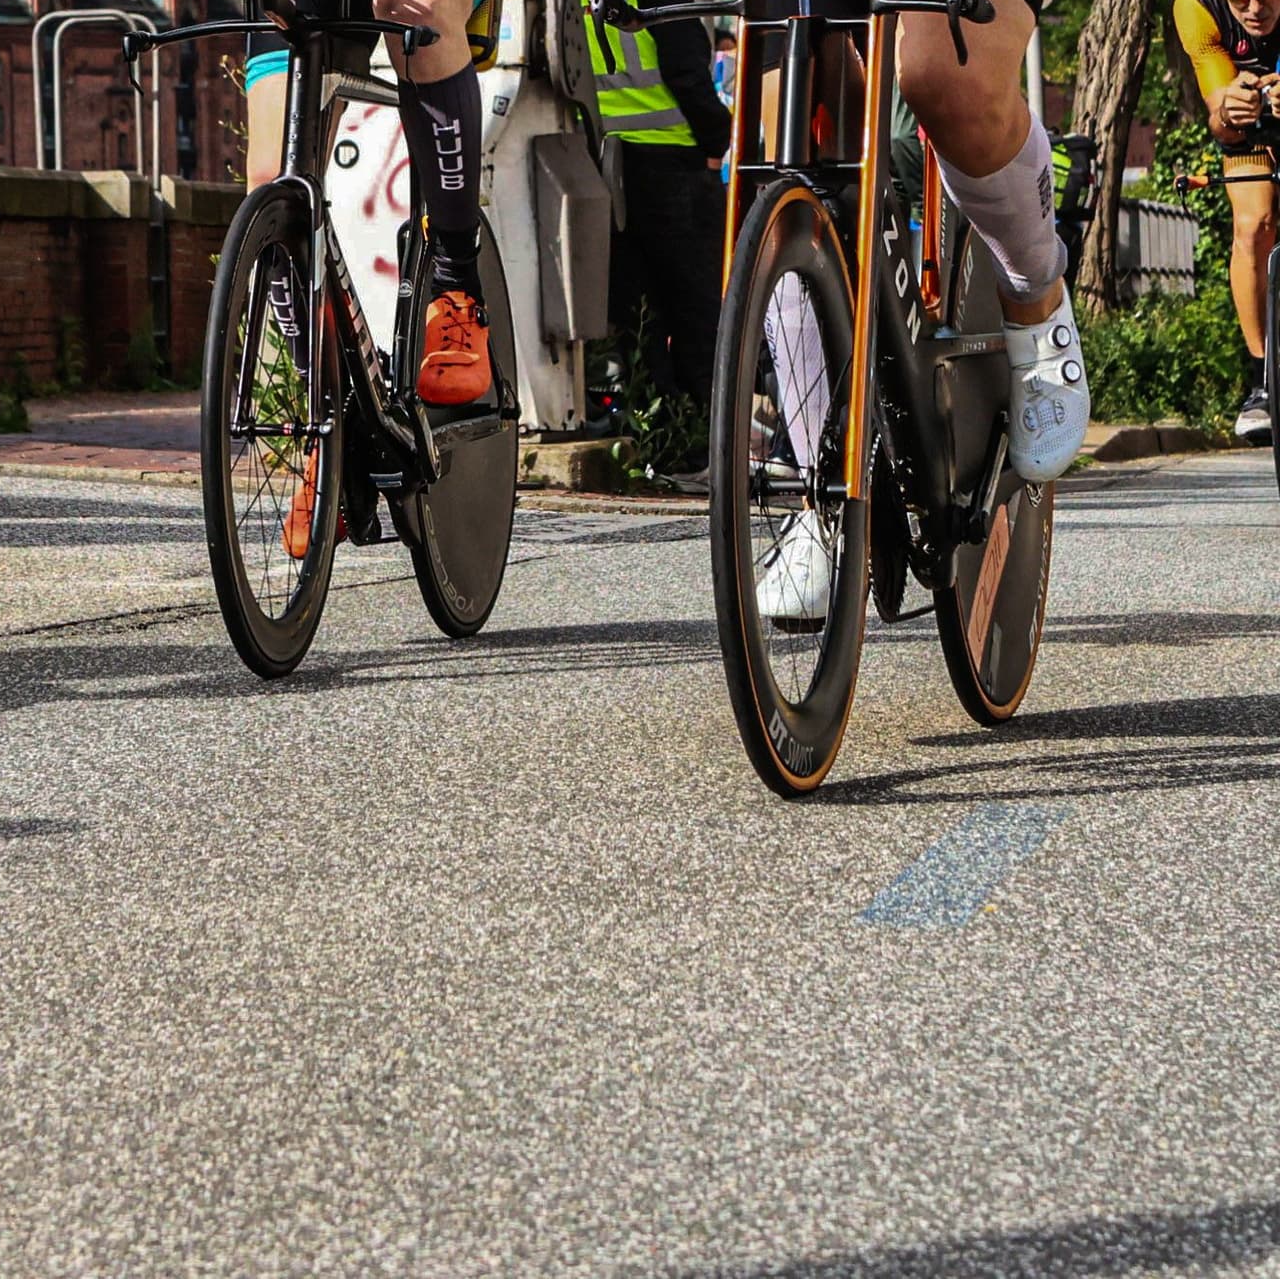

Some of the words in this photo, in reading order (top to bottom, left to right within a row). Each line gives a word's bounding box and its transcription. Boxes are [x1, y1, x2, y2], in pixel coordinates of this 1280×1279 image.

[432, 118, 465, 190] HUUB
[270, 276, 301, 337] HUUB
[768, 708, 789, 754] DT
